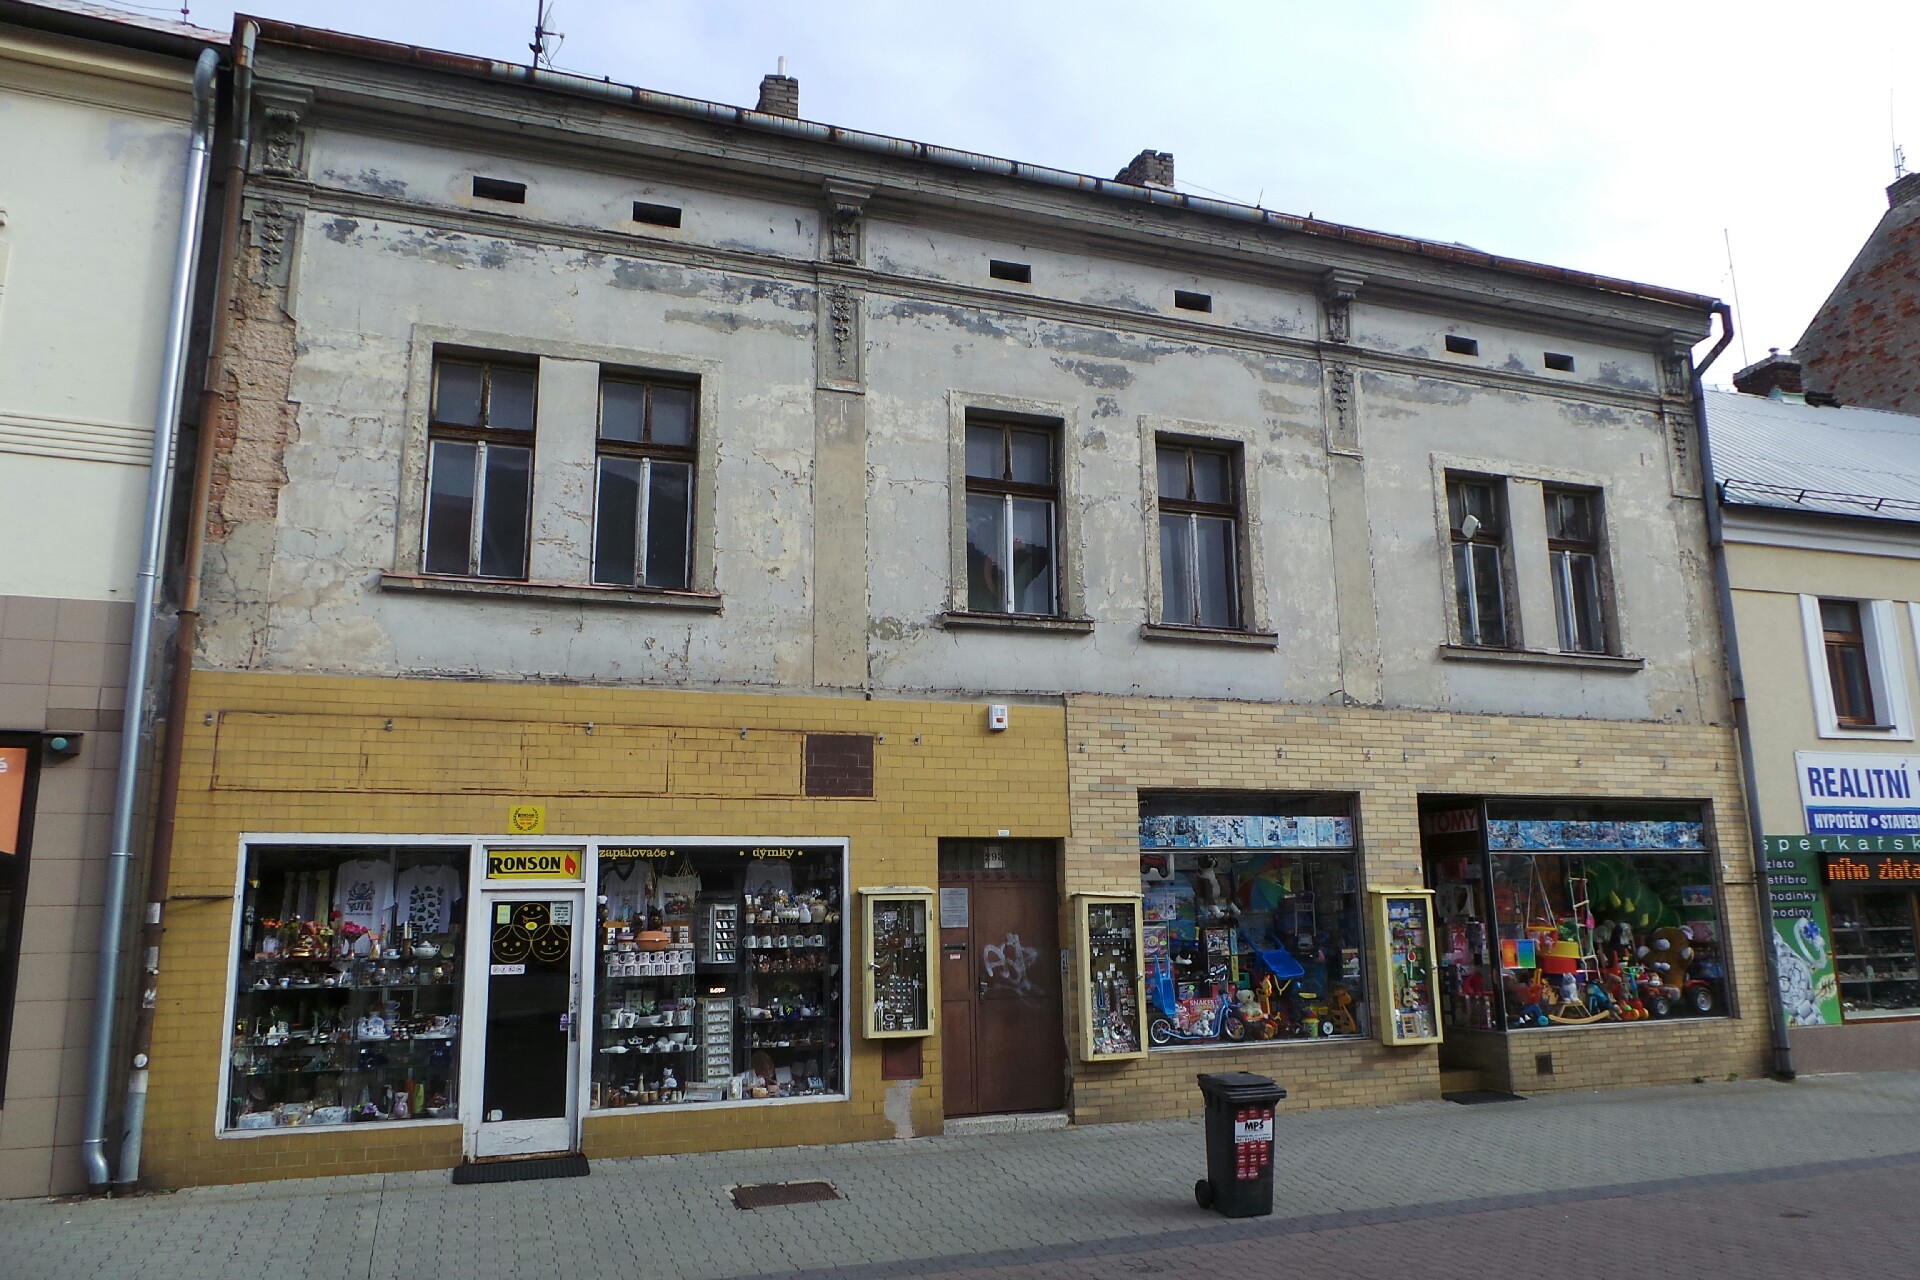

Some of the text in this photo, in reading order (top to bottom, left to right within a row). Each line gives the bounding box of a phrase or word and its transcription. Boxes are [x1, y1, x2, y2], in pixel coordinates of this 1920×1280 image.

[1807, 763, 1911, 798] REALITNÍ
[1814, 811, 1920, 829] HYPOTÉKY STAVEB
[599, 848, 667, 859] zapalovače
[752, 848, 795, 860] dýmky
[489, 856, 561, 874] RONSON
[1766, 859, 1795, 869] zlato
[1767, 874, 1808, 885] stříbro
[1770, 891, 1817, 902] hodinky
[1772, 908, 1812, 919] hodiny
[1244, 1120, 1264, 1131] MPS
